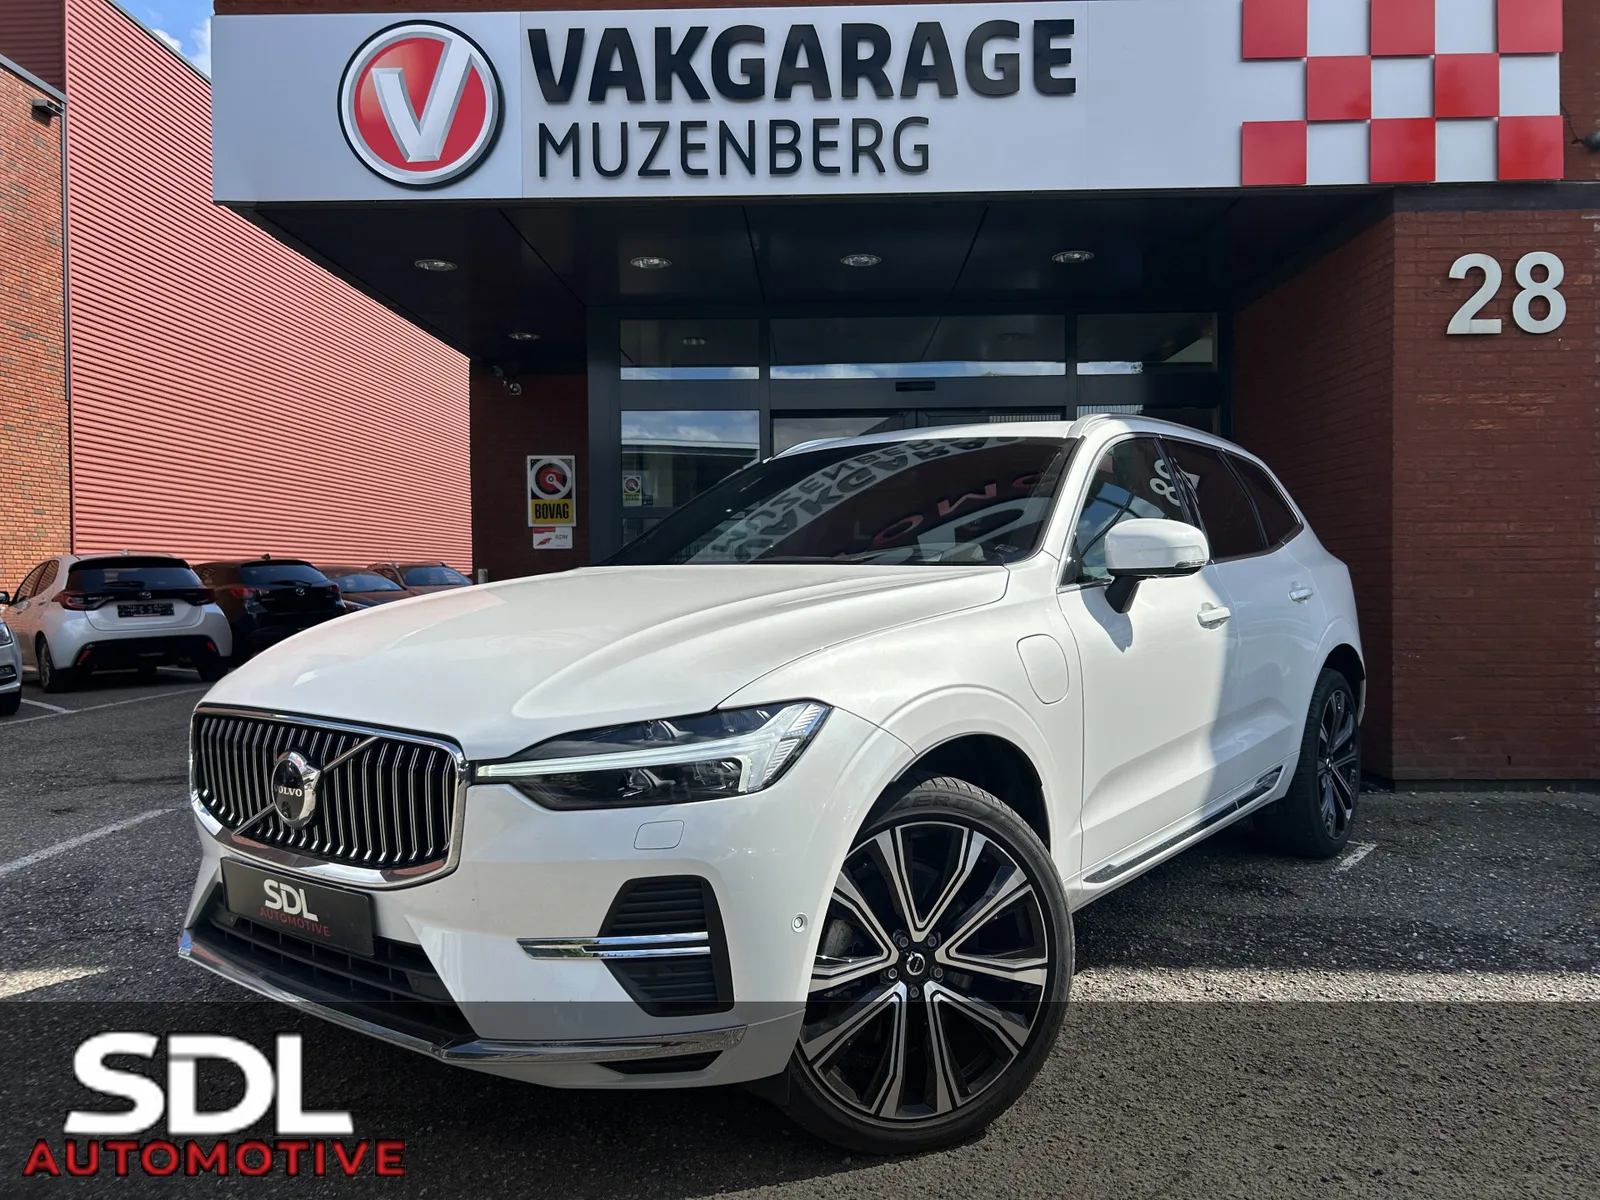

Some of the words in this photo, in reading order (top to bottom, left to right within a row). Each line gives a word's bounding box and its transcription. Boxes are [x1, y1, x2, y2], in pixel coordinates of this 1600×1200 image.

[527, 19, 1077, 103] VAKGARAGE
[370, 34, 473, 163] V
[538, 116, 931, 178] MUZENBERG
[1447, 251, 1567, 334] 28
[535, 503, 569, 519] BOVAG
[260, 908, 331, 936] AUTOMOTIVE
[264, 880, 318, 921] SDL
